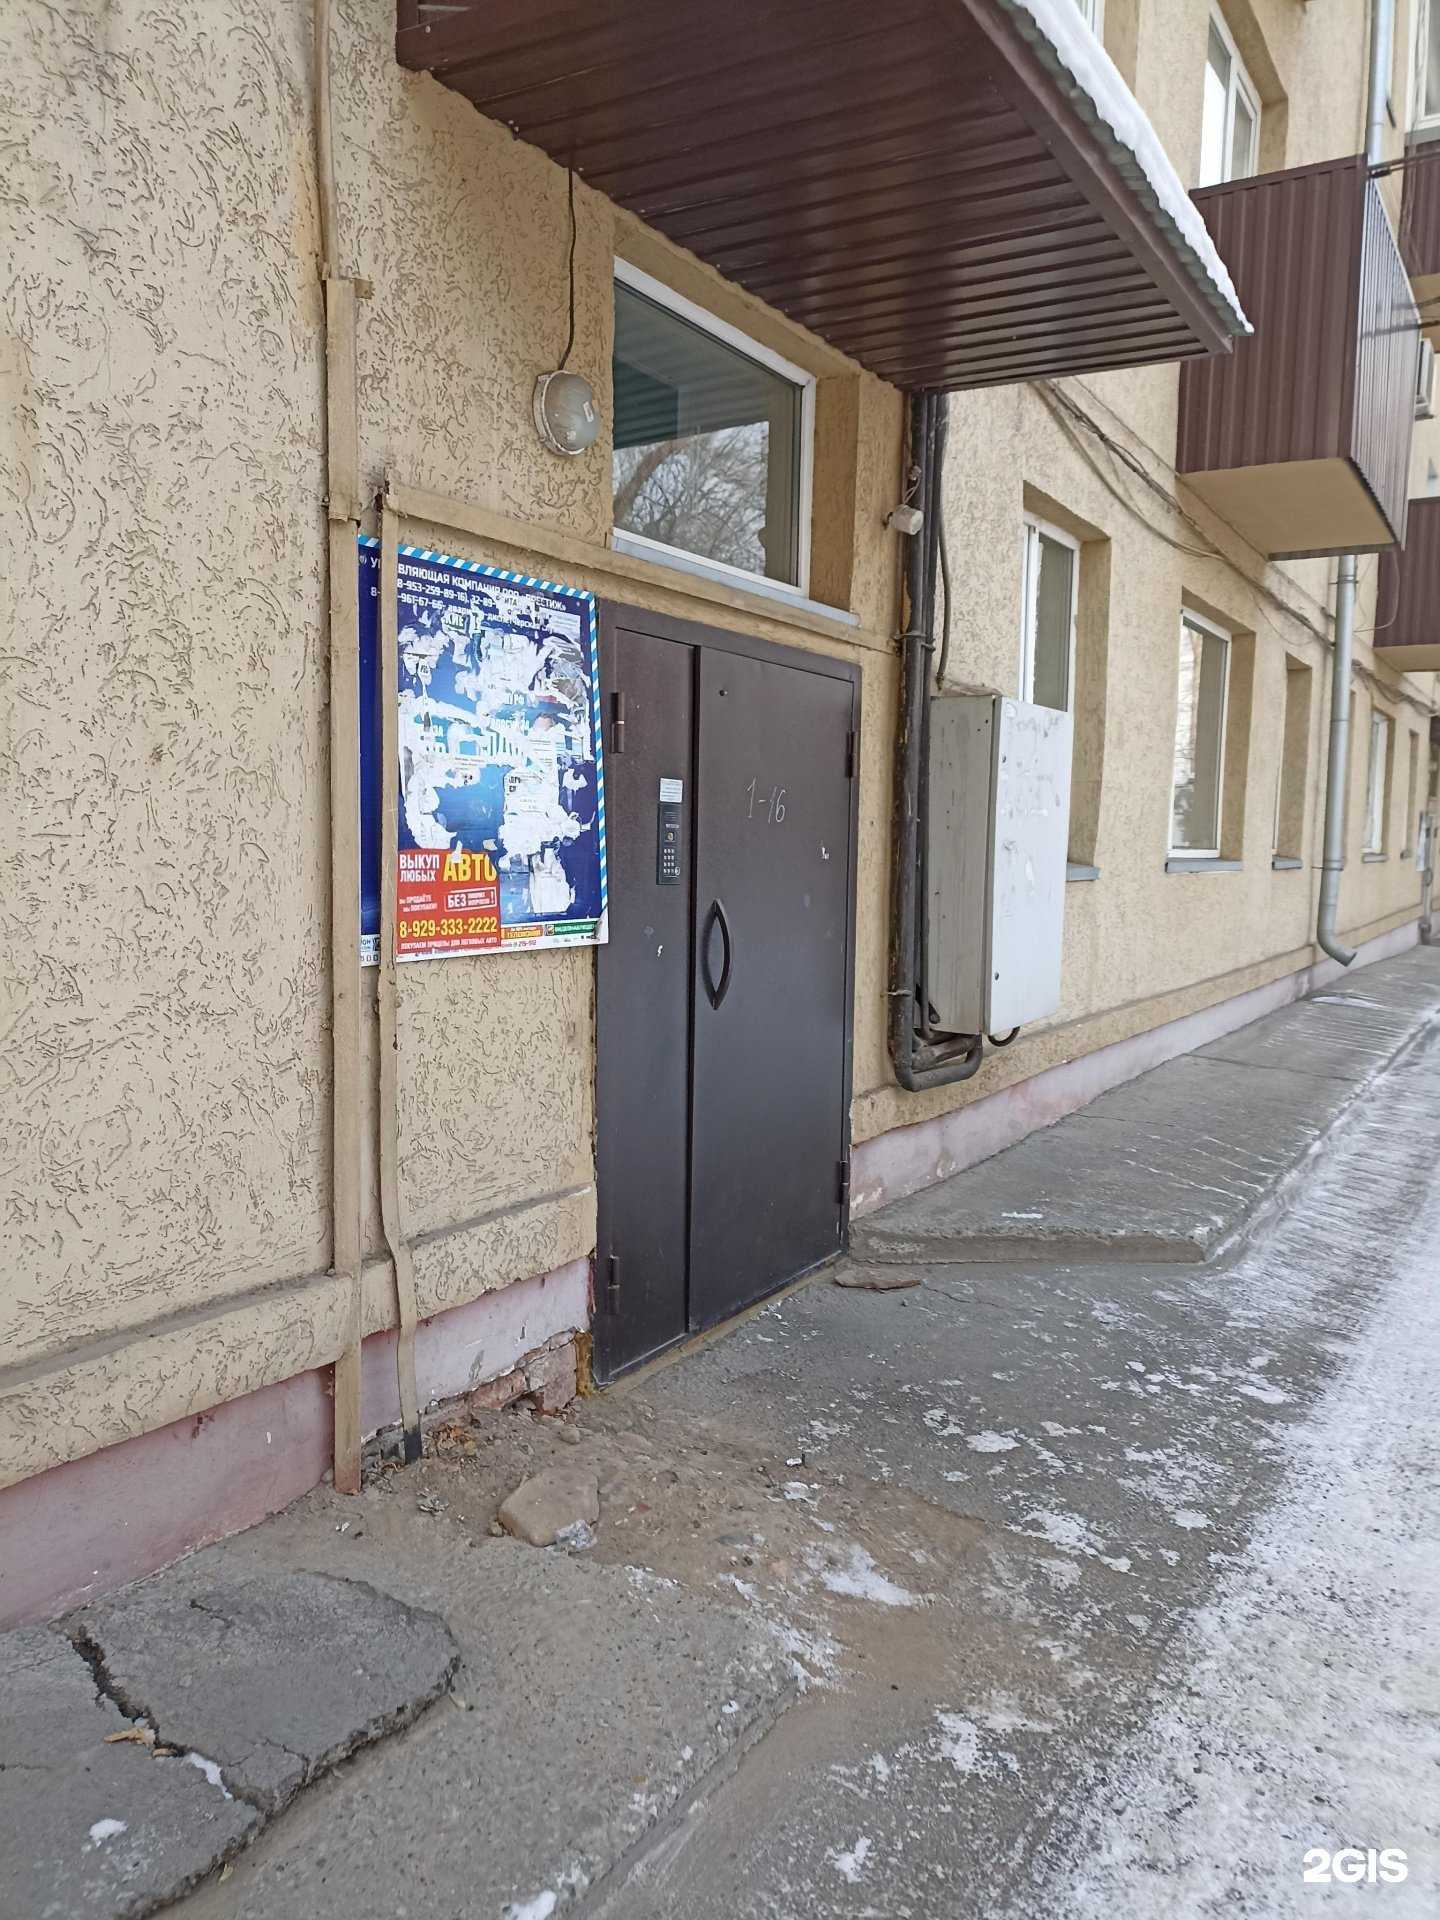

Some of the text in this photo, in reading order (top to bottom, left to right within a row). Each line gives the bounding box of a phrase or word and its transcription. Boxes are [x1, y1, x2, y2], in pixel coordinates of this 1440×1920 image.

[746, 776, 787, 824] 1-16
[400, 854, 440, 869] ВЫКУП
[400, 869, 436, 882] ЛЮБЫХ
[447, 894, 467, 908] БЕЗ
[400, 917, 497, 938] 8-929-333-2222
